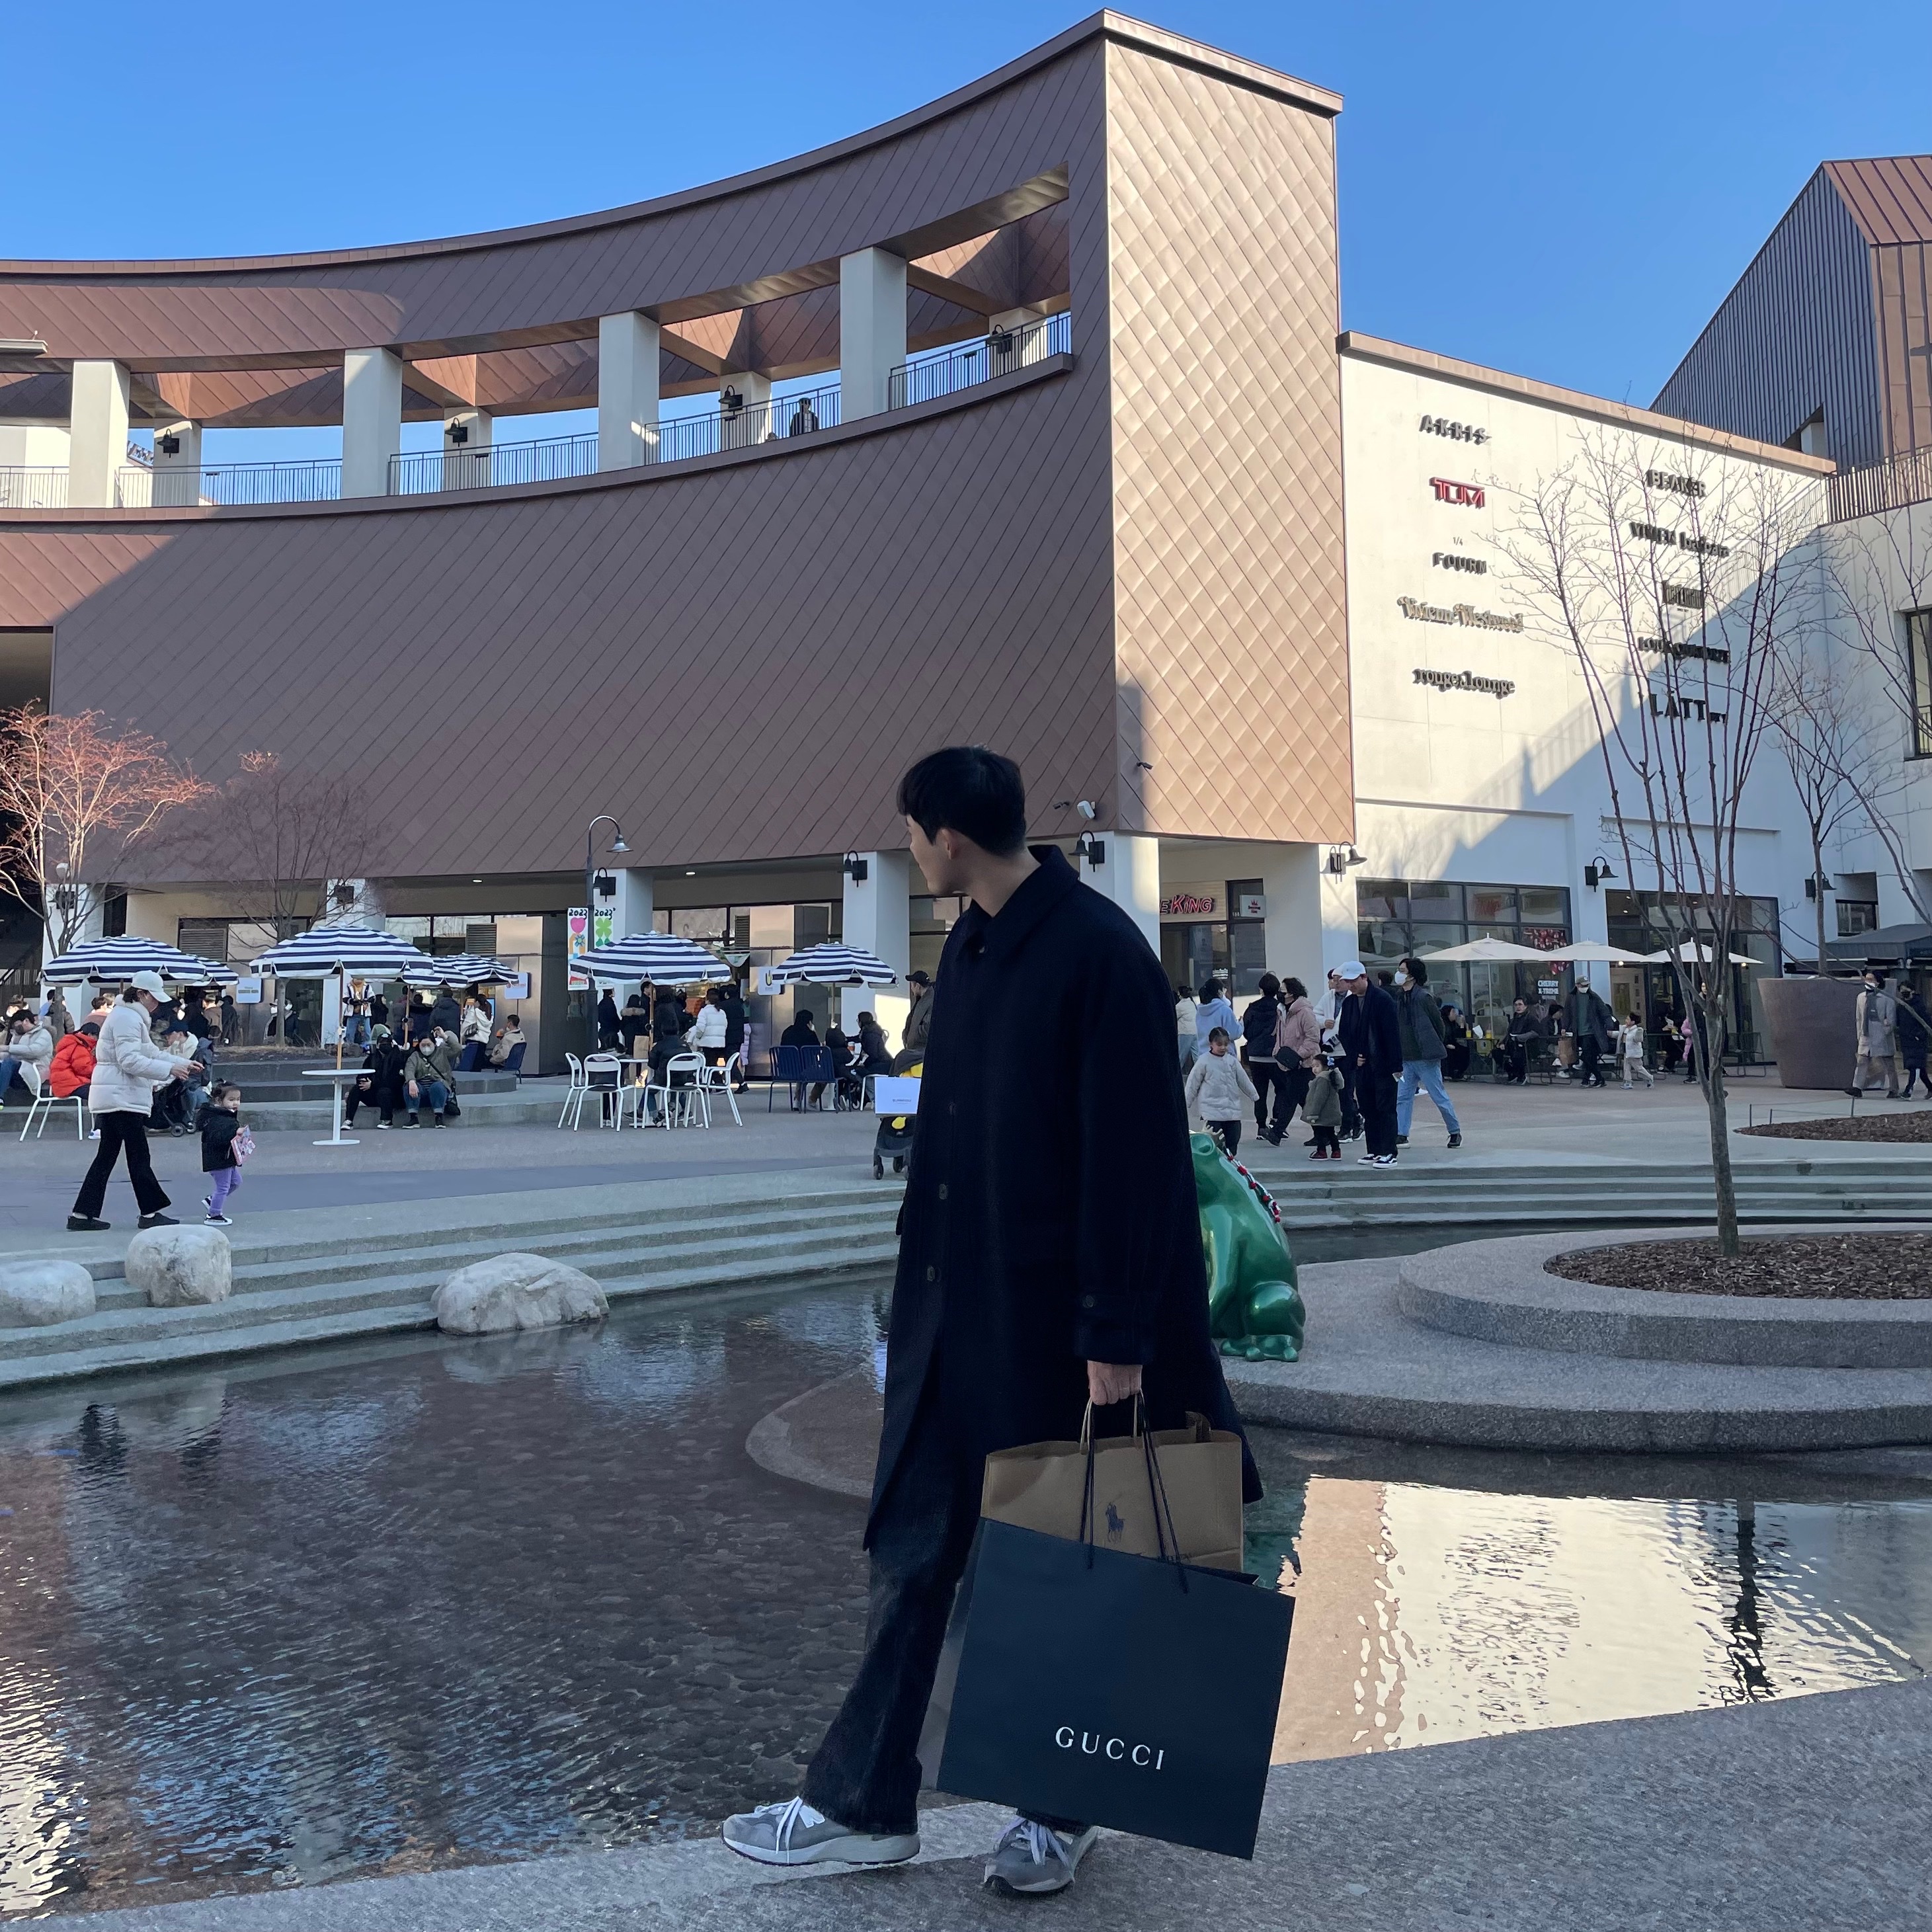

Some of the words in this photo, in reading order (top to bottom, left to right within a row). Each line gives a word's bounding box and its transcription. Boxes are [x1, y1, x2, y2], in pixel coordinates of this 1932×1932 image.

[1419, 415, 1488, 446] AKRIS
[1646, 469, 1707, 499] BEAKER
[569, 908, 588, 920] 2023
[594, 908, 613, 920] 2023
[1055, 1726, 1164, 1770] GUCCI
